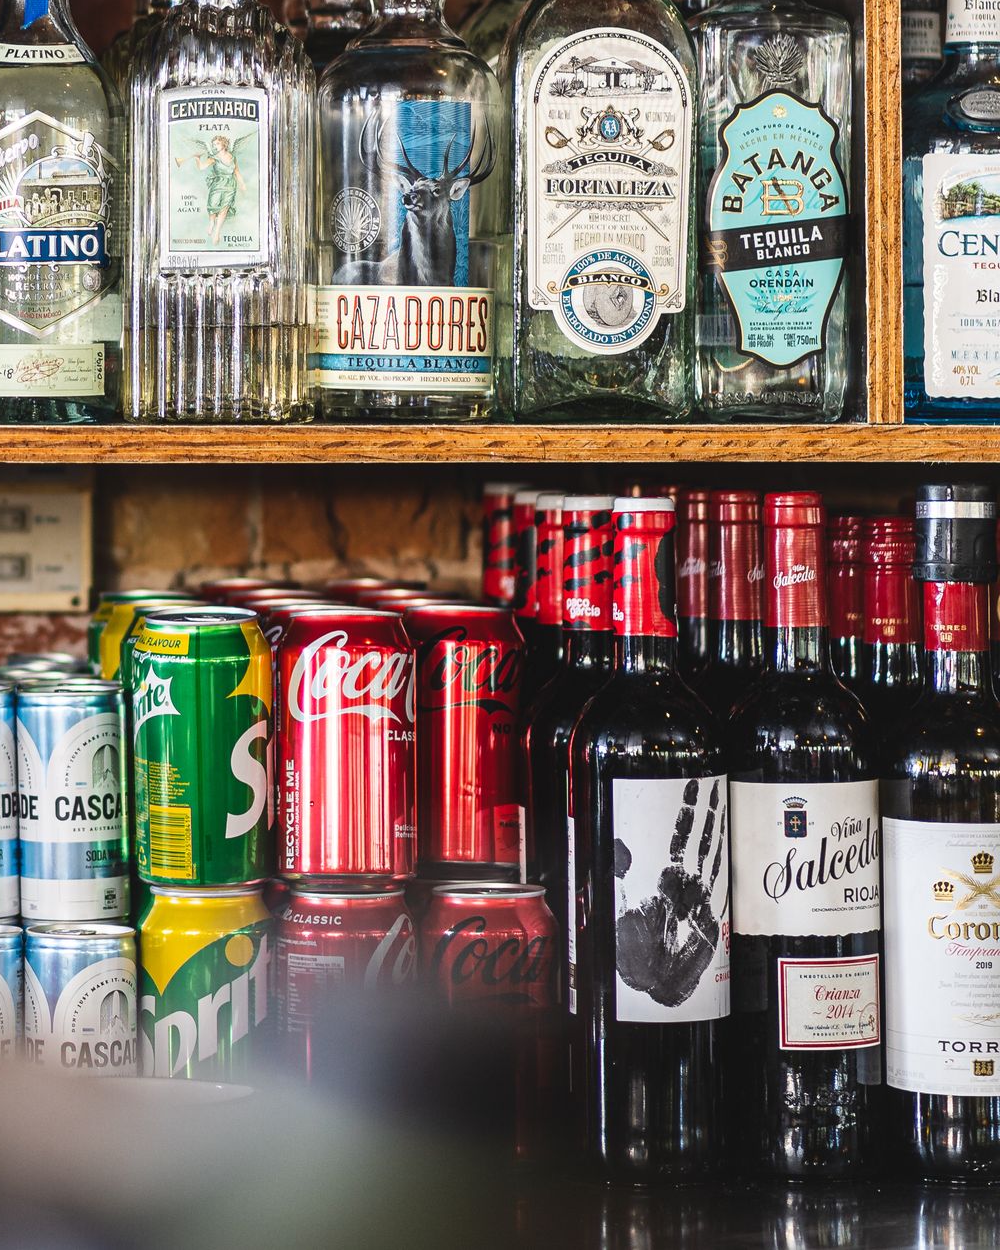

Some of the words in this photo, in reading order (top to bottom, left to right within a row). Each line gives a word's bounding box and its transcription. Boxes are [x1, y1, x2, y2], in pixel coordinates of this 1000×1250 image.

[4, 48, 65, 59] PLATINO
[171, 100, 257, 119] CENTENARIO
[199, 123, 231, 132] PLATA
[742, 126, 760, 137] 100%
[797, 126, 820, 139] AGAVE
[739, 133, 768, 151] HECHO
[789, 132, 825, 152] MÉXICO
[571, 152, 645, 169] TEQUILA
[721, 147, 840, 213] BATANGA
[545, 178, 677, 199] FORTALEZA
[223, 235, 253, 243] TEQUILA
[363, 217, 380, 247] AGAVE
[739, 225, 824, 250] TEQUILA
[545, 243, 564, 252] ESTATE
[574, 232, 601, 248] HECHO
[603, 232, 615, 245] EN
[616, 232, 645, 252] MEXICO
[654, 245, 672, 256] STONE
[756, 244, 811, 261] BLANCO
[542, 254, 566, 265] BOTTLED
[574, 254, 596, 274] 100%
[597, 251, 613, 261] DE
[613, 252, 644, 275] AGAVE
[651, 256, 675, 268] GROUND
[576, 274, 643, 286] BLANCO
[765, 269, 800, 278] CASA
[15, 282, 64, 292] RESERVA
[749, 278, 814, 288] ORENDAIN
[754, 300, 783, 321] Family
[784, 301, 808, 314] Estate
[337, 294, 488, 352] CAZADORES
[562, 294, 609, 344] ELABORADO
[611, 332, 629, 344] EN
[628, 296, 655, 340] TAHONA
[959, 318, 984, 327] 100%
[796, 334, 819, 345] 750ml
[347, 357, 417, 372] TEQUILA
[423, 358, 479, 369] BLANCO
[952, 365, 966, 375] 40%
[773, 566, 816, 590] Salceda
[566, 597, 590, 609] paco
[569, 604, 600, 619] garcía
[147, 636, 181, 649] FLAVOUR
[69, 747, 82, 763] JUST
[82, 734, 100, 747] MAKE
[285, 759, 295, 787] ME
[285, 791, 295, 870] RECYCLE
[830, 816, 862, 843] Viña
[85, 850, 109, 862] SODA
[763, 817, 879, 904] Salceda
[843, 885, 879, 903] RIOJA
[293, 913, 342, 925] CLASSIC
[975, 961, 993, 969] 2019
[77, 992, 90, 1009] JUST
[90, 979, 110, 992] MAKE
[814, 984, 861, 1001] Crianza
[826, 1003, 854, 1019] 2014
[938, 1040, 1000, 1053] TORR
